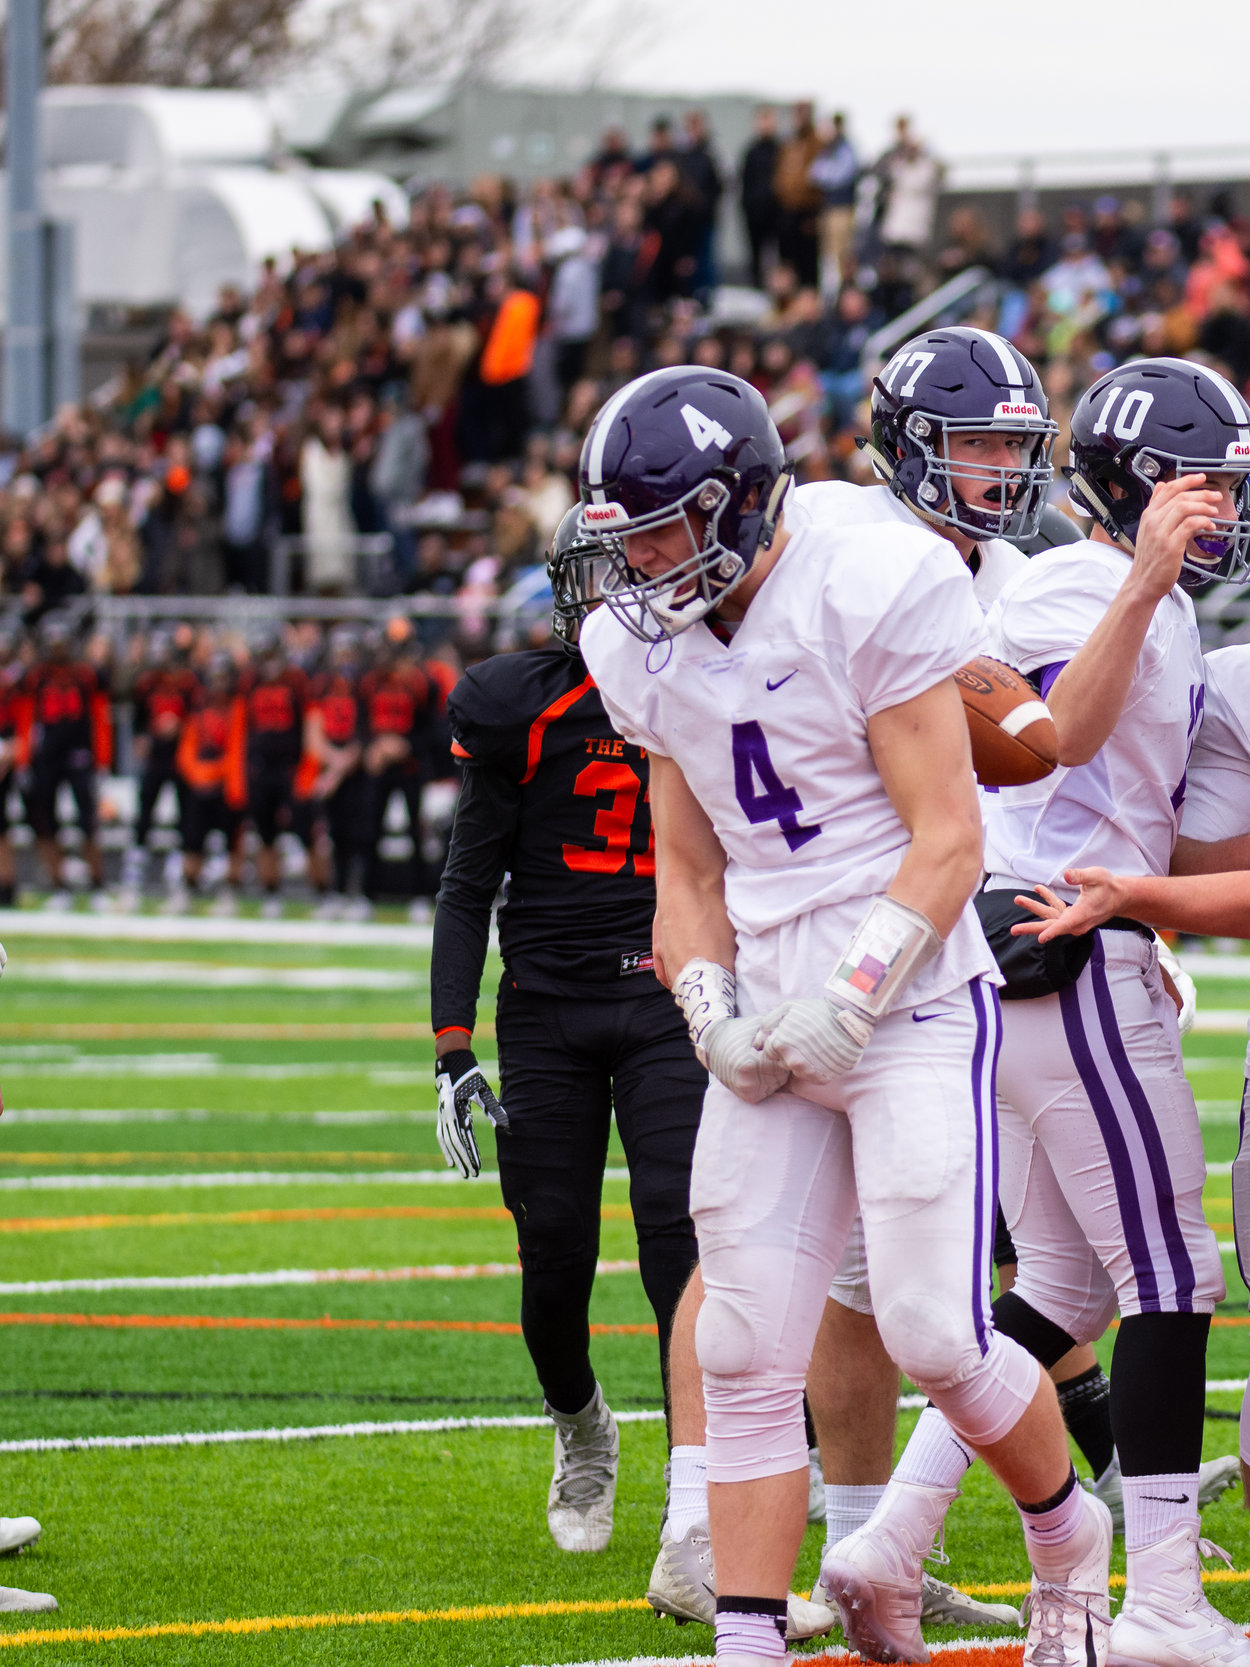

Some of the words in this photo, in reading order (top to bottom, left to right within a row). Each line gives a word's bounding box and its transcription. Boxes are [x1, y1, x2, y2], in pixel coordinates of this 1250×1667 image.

[885, 351, 936, 397] 77
[680, 403, 733, 452] 4
[1001, 405, 1038, 416] Riddell
[1093, 386, 1154, 441] 10
[585, 508, 618, 521] Riddell
[585, 738, 625, 757] THE
[731, 720, 821, 852] 4
